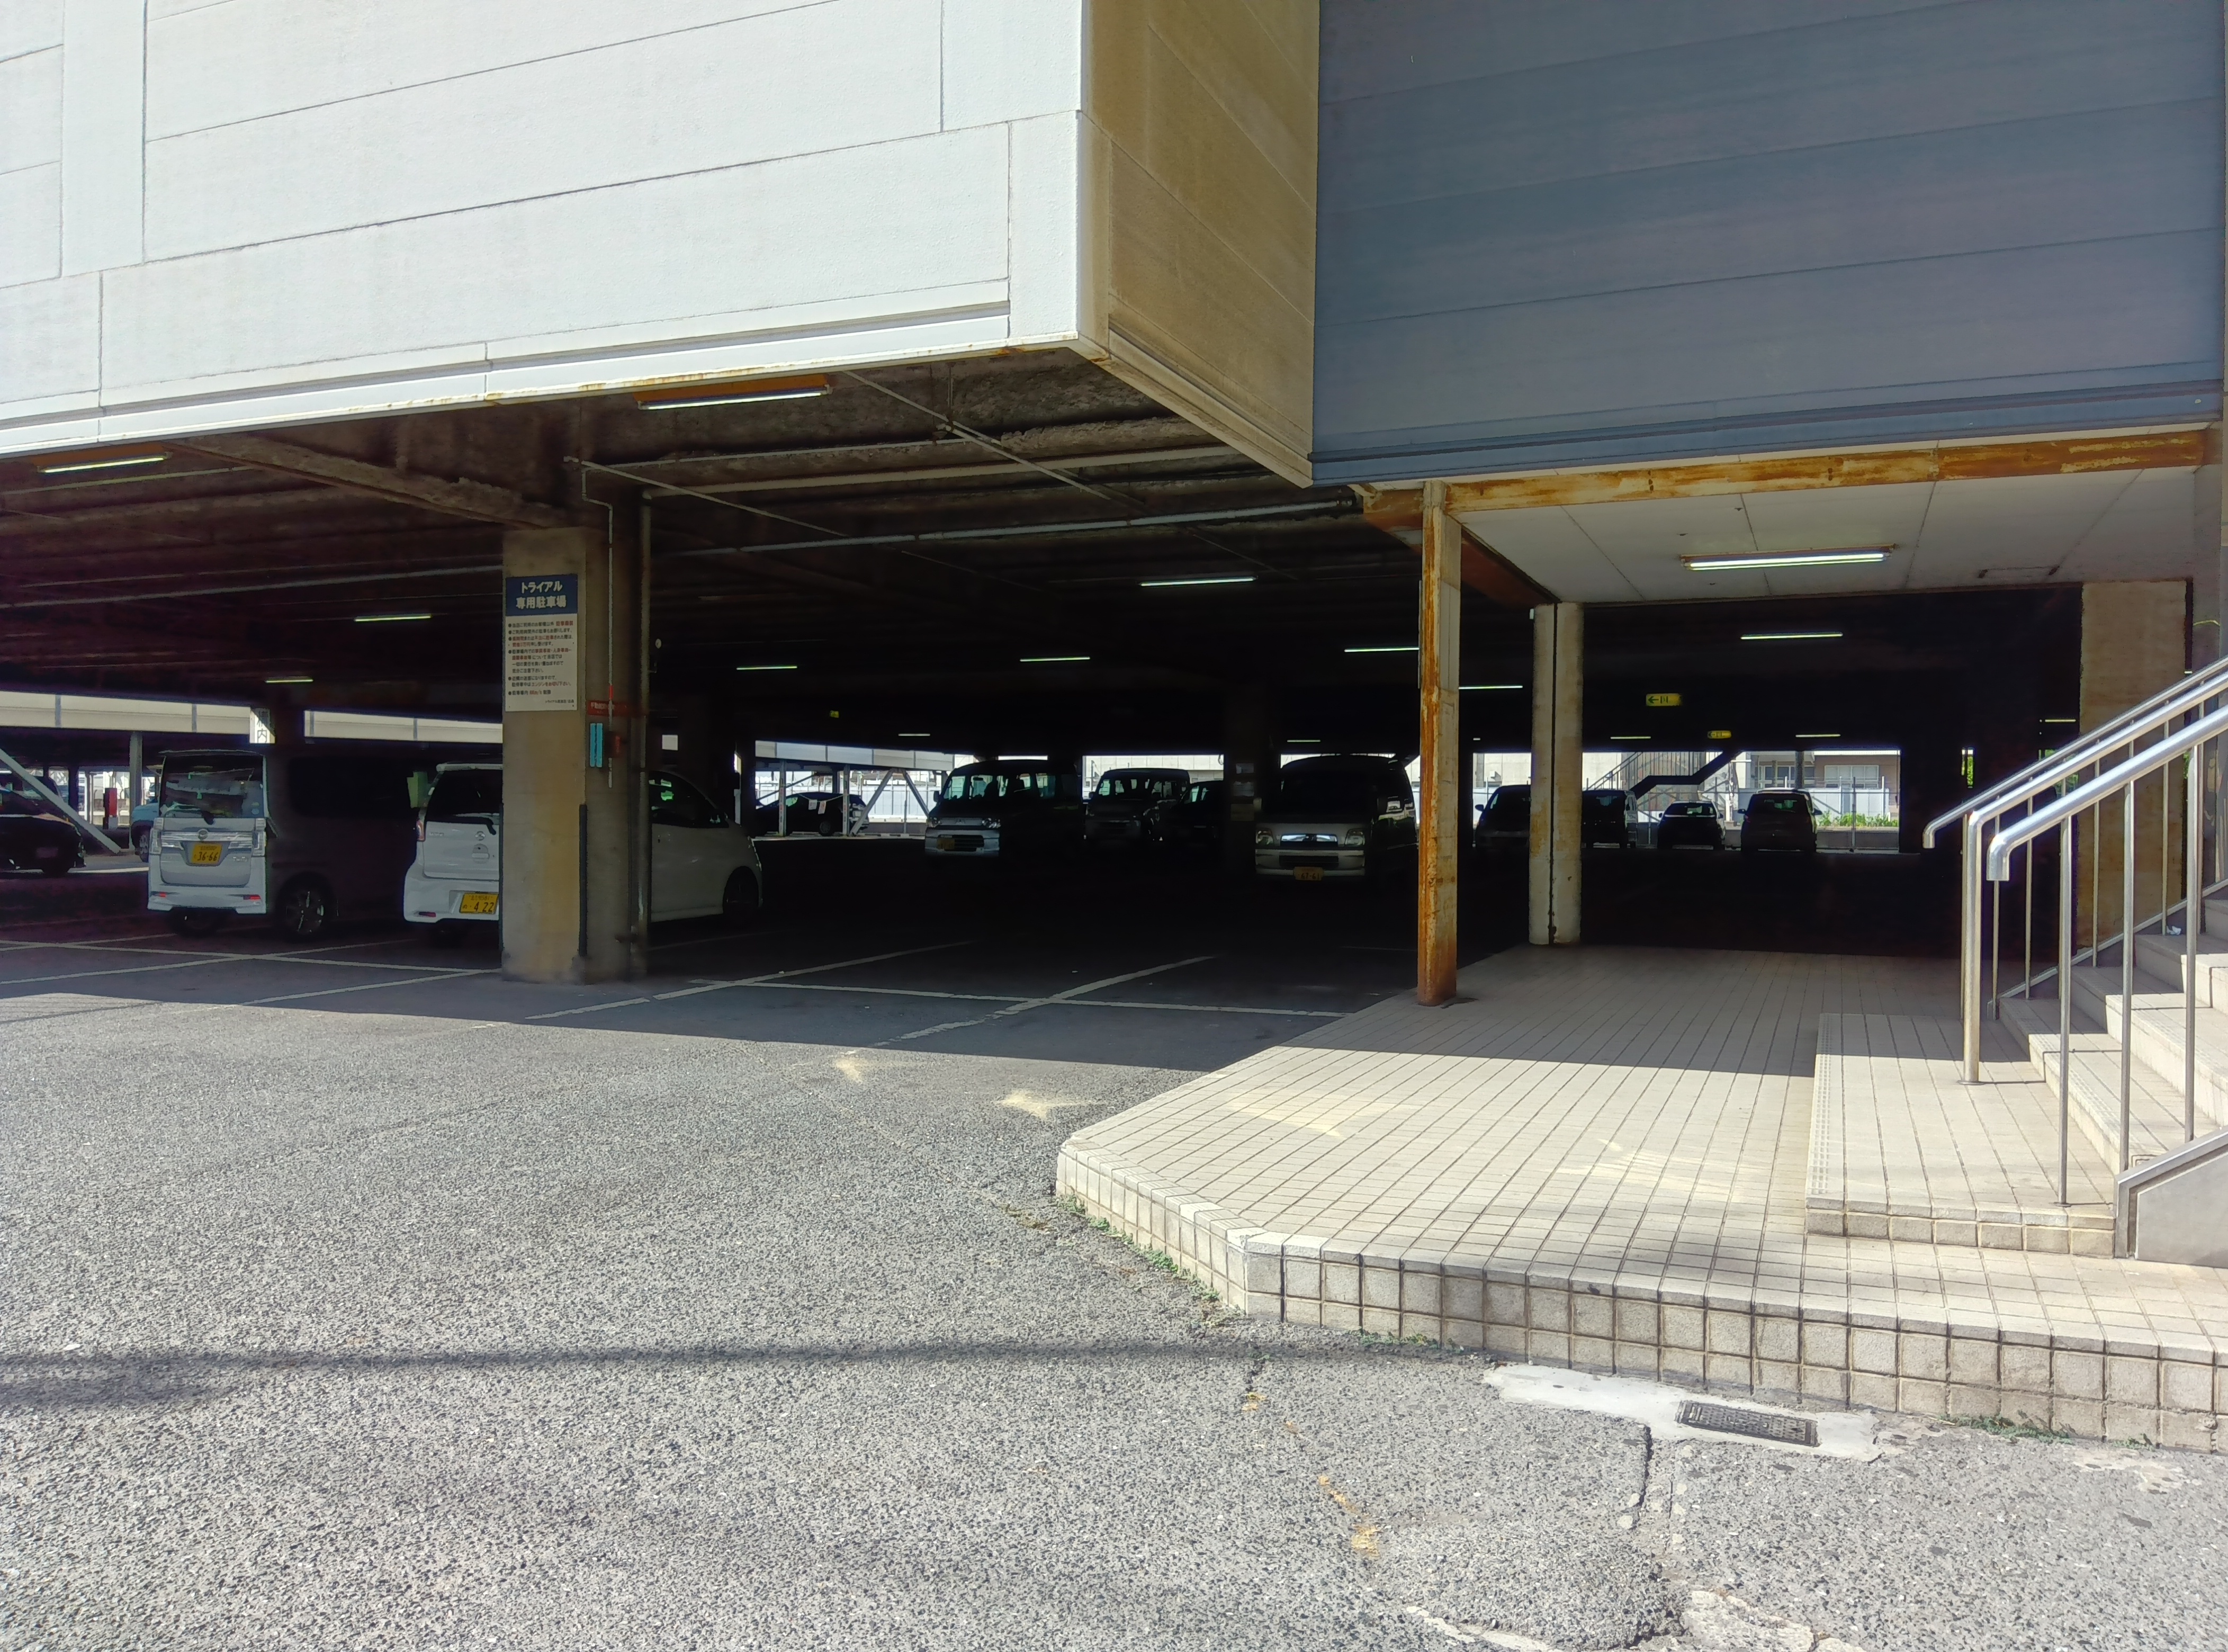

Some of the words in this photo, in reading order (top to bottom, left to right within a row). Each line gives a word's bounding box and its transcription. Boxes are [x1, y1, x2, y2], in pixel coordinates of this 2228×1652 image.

[522, 581, 563, 594] トライアル
[516, 595, 567, 609] 専用駐車場
